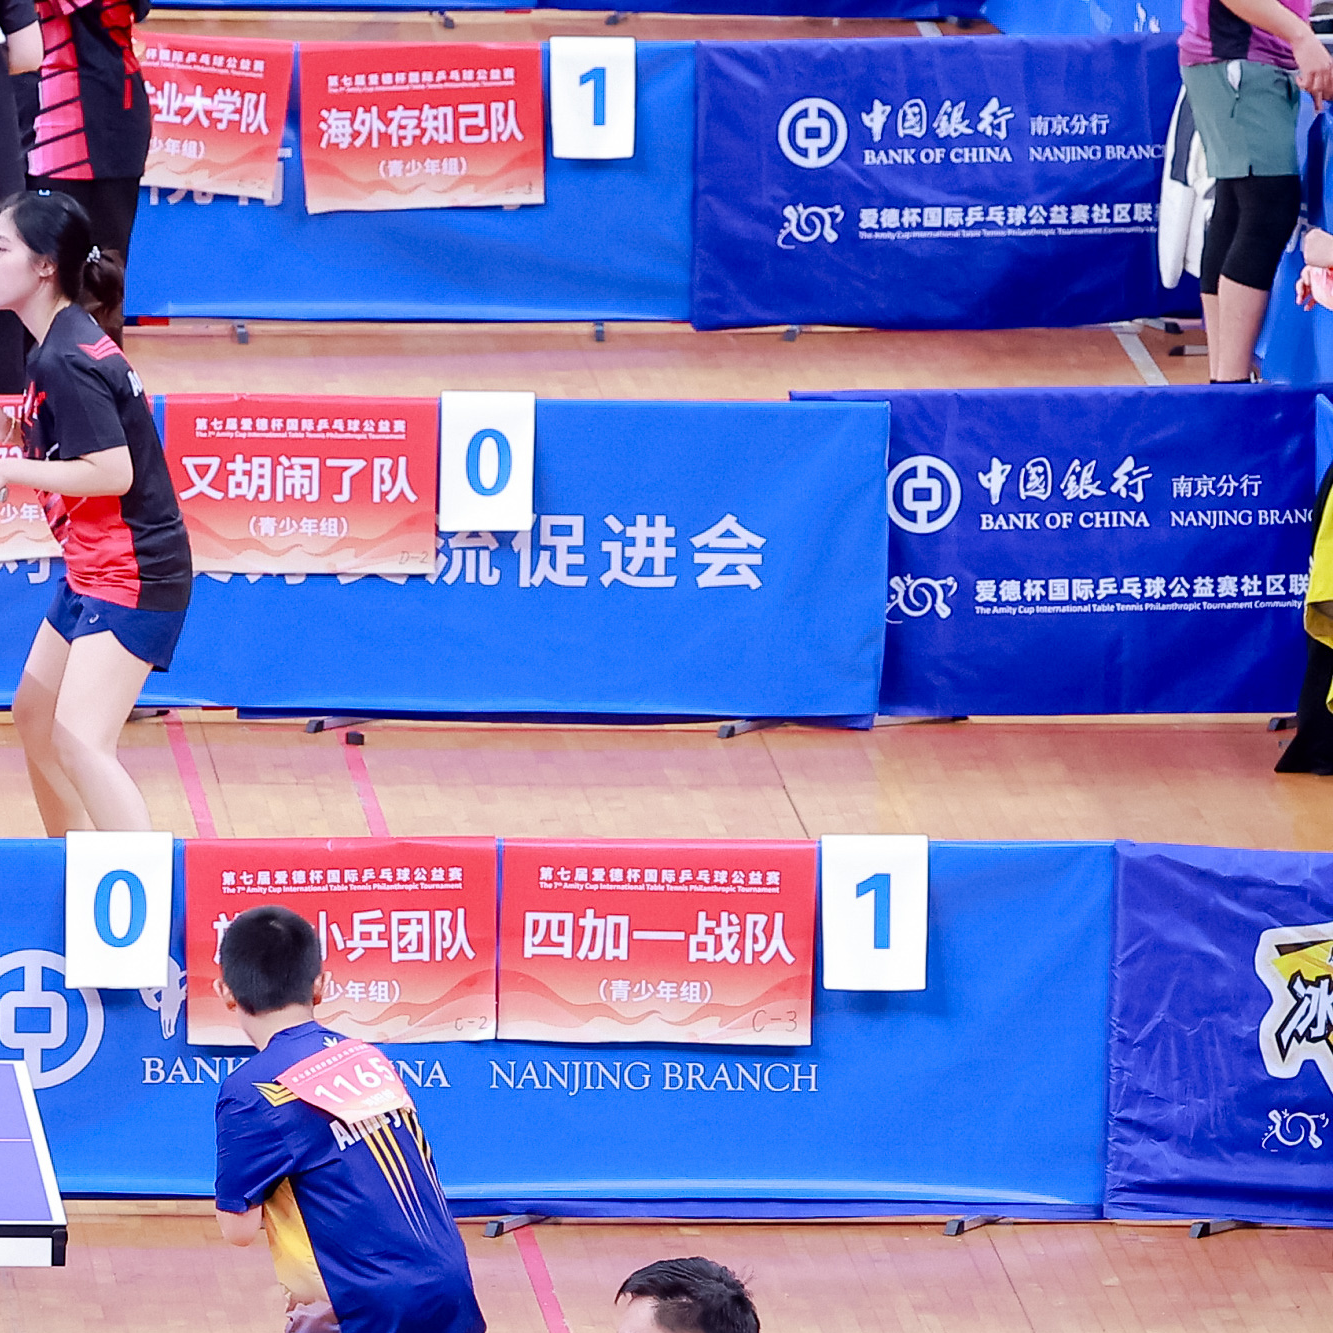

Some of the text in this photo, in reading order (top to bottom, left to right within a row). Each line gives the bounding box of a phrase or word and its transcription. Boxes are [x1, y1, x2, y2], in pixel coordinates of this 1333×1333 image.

[577, 67, 607, 126] 1
[318, 99, 525, 149] 海外存知己队
[1030, 113, 1110, 136] 南京分行
[863, 149, 916, 166] BANK
[920, 148, 946, 164] OF
[950, 147, 1013, 164] CHINA
[1029, 146, 1101, 165] NANJING
[859, 203, 1159, 229] 爱德杯国际乒乓球公益赛社区联
[180, 453, 419, 504] 又胡闹了队
[465, 428, 511, 496] 0
[1171, 474, 1263, 498] 南京分行
[980, 513, 1040, 530] BANK
[1046, 513, 1074, 530] OF
[1079, 511, 1150, 528] CHINA
[1170, 510, 1253, 529] NANJING
[975, 574, 1310, 603] 爱德杯国际乒乓球公益赛社区联
[975, 600, 1302, 615] The Amity Cup International Table Tennis Philanthropic Tournament Community
[221, 867, 463, 886] 第七届爱德杯国际乒乓球公益赛
[539, 866, 781, 886] 第七届爱德杯国际乒乓球公益赛
[93, 869, 146, 949] 0
[854, 873, 891, 950] 1
[213, 908, 477, 965] 小乒团队
[523, 909, 796, 965] 四加一战队
[314, 1056, 396, 1104] 1165
[489, 1060, 651, 1096] NANJING
[662, 1062, 818, 1093] BRANCH
